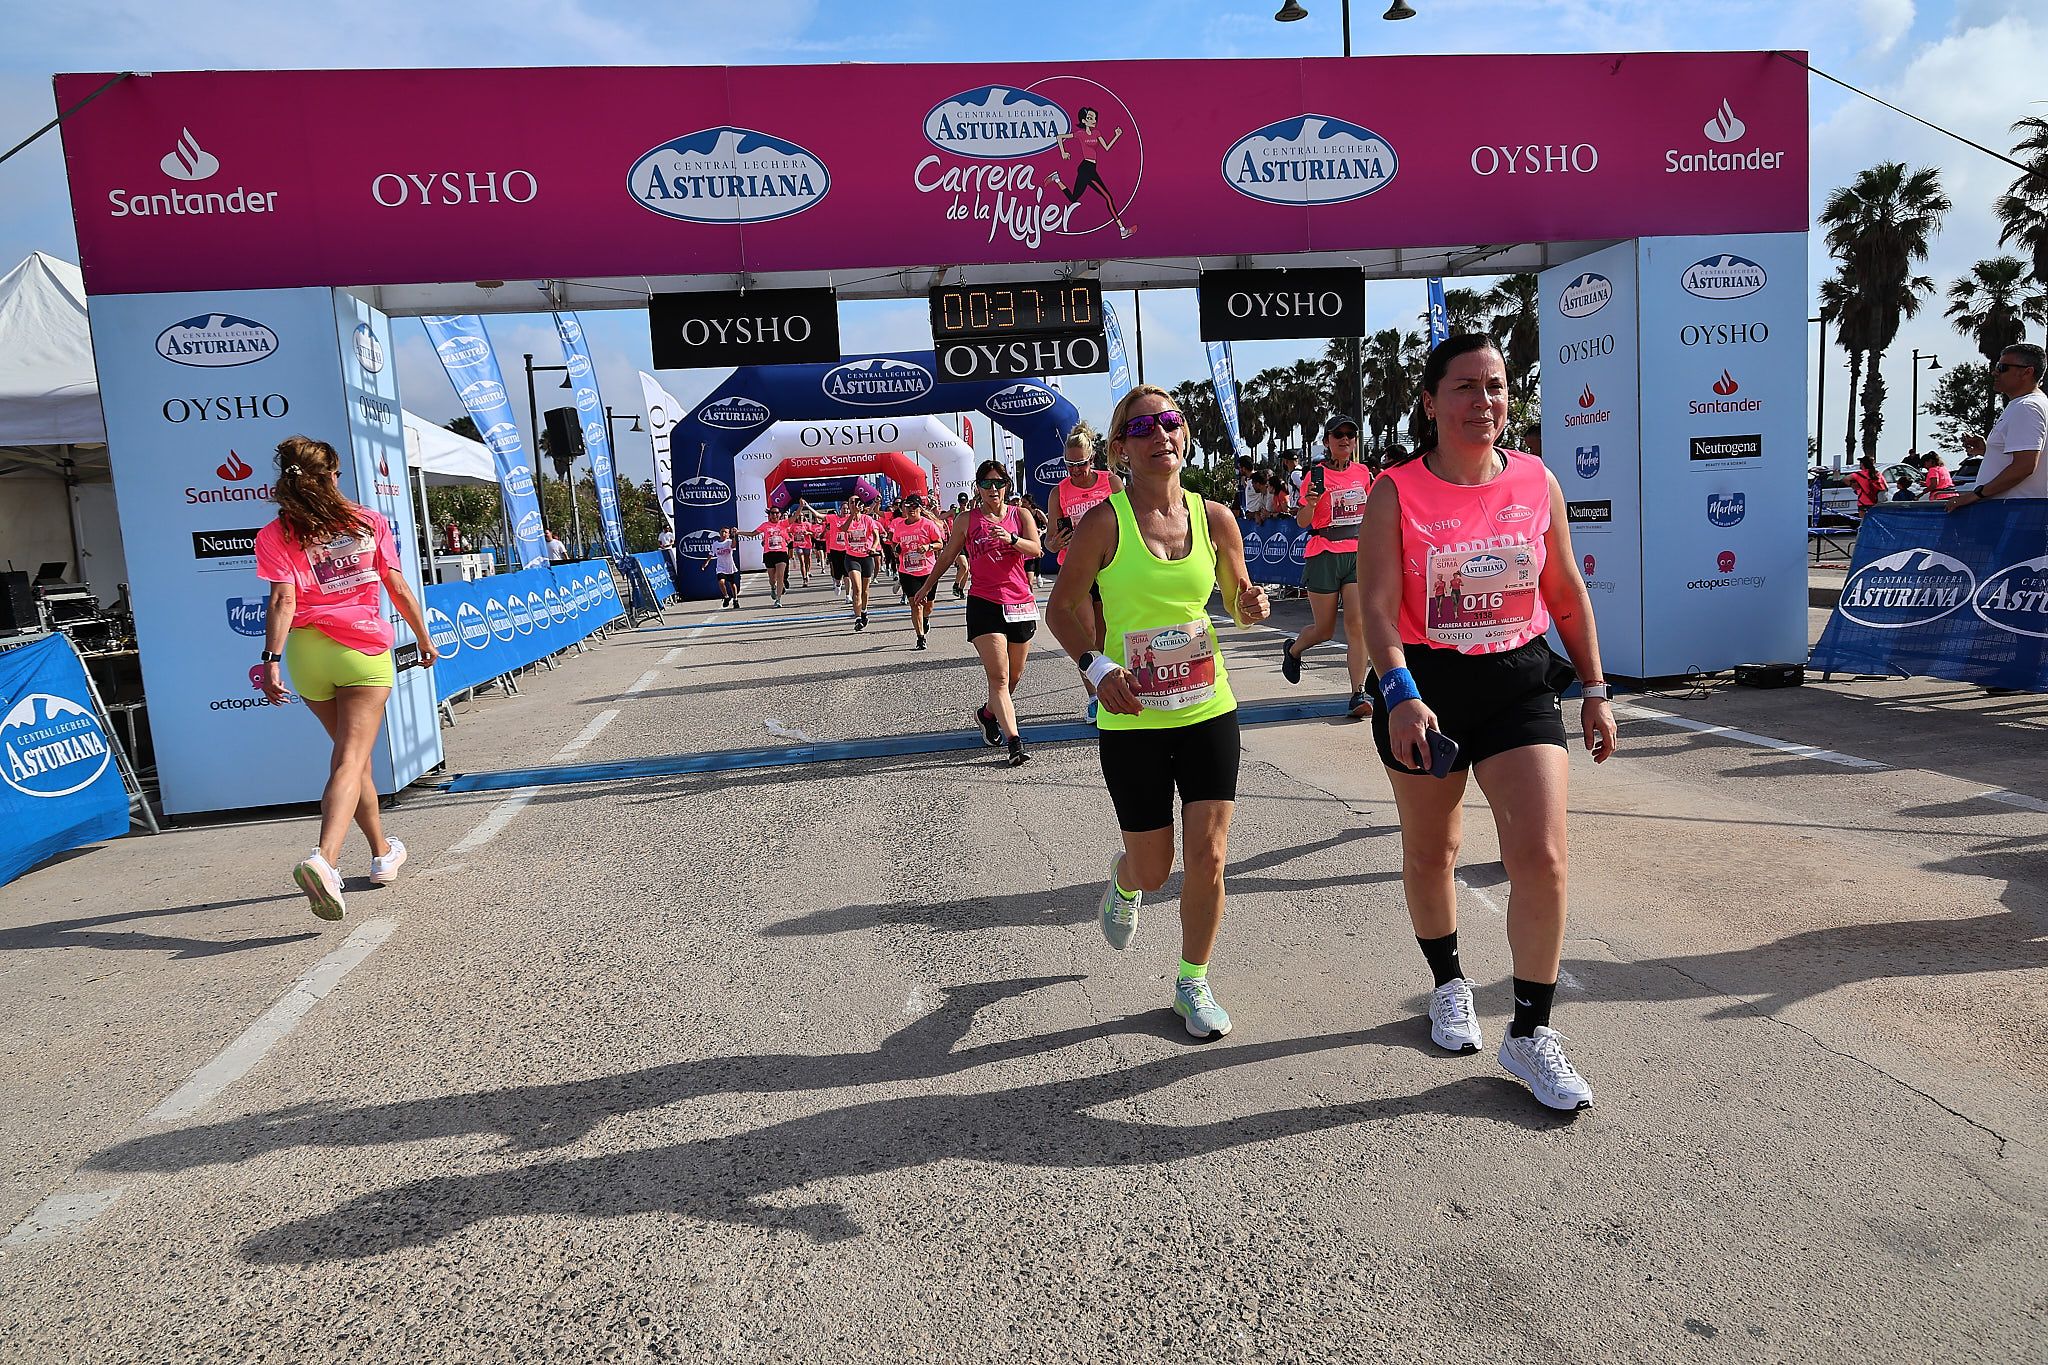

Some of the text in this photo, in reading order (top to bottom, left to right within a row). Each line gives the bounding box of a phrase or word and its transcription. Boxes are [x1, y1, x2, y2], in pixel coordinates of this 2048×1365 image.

[957, 110, 1054, 119] CENTRAL LECHERA
[936, 113, 1060, 141] ASTURIANA
[1263, 145, 1379, 156] CENTRAL LECHERA
[1471, 143, 1598, 176] OYSHO
[674, 159, 807, 171] CENTRAL LECHERA
[1237, 150, 1385, 184] ASTURIANA
[1665, 147, 1785, 173] Santander
[645, 164, 816, 200] ASTURIANA
[914, 155, 1036, 193] Carrera
[371, 169, 539, 208] OYSHO
[108, 187, 278, 218] Santander
[946, 192, 990, 220] de la
[988, 187, 1082, 249] Mujer
[1687, 272, 1760, 289] ASTURIANA
[943, 287, 1092, 330] 00:37:10
[1227, 291, 1343, 318] OYSHO
[1563, 288, 1608, 311] ASTURIANA
[682, 315, 811, 346] OYSHO
[1680, 322, 1769, 346] OYSHO
[165, 334, 271, 356] ASTURIANA
[1559, 334, 1614, 365] OYSHO
[944, 337, 1100, 377] OYSHO
[831, 374, 926, 395] ASTURIANA
[162, 393, 289, 423] OYSHO
[359, 395, 391, 425] OYSHO
[992, 395, 1052, 410] ASTURIANA
[1689, 397, 1762, 415] Santander
[702, 409, 765, 421] ASTURIANA
[1564, 409, 1611, 428] Santander
[800, 422, 899, 448] OYSHO
[927, 440, 957, 449] OYSHO
[1695, 441, 1757, 456] Neutrogena
[741, 452, 773, 461] OYSHO
[791, 454, 876, 468] Sports Santander
[1038, 468, 1070, 480] ASTUR
[185, 483, 277, 505] Santande
[679, 488, 728, 499] ASTURIANA
[736, 493, 760, 502] YSHO
[1344, 504, 1358, 512] 016
[1570, 505, 1609, 520] Neutrogena
[1709, 500, 1743, 520] Marlene
[200, 536, 256, 552] Neutro
[334, 554, 360, 569] 016
[1436, 561, 1459, 569] SUMA
[1463, 564, 1504, 574] ASTURIANA
[1687, 575, 1766, 590] octopus energy
[1871, 575, 1963, 584] CENTRAL LECHERA
[1463, 592, 1503, 610] 016
[1843, 578, 1960, 608] ASTURIANA
[230, 605, 266, 627] Marle
[1474, 611, 1493, 620] 3138
[1501, 616, 1524, 624] VALENCIA
[1154, 637, 1188, 648] ASTURIANA
[1438, 632, 1473, 640] OYSHO
[1157, 662, 1191, 680] 016
[210, 697, 271, 711] octopus
[1141, 698, 1170, 707] OYSHO
[17, 718, 92, 747] CENTRAL LECHERA
[5, 731, 107, 783] ASTURIANA
